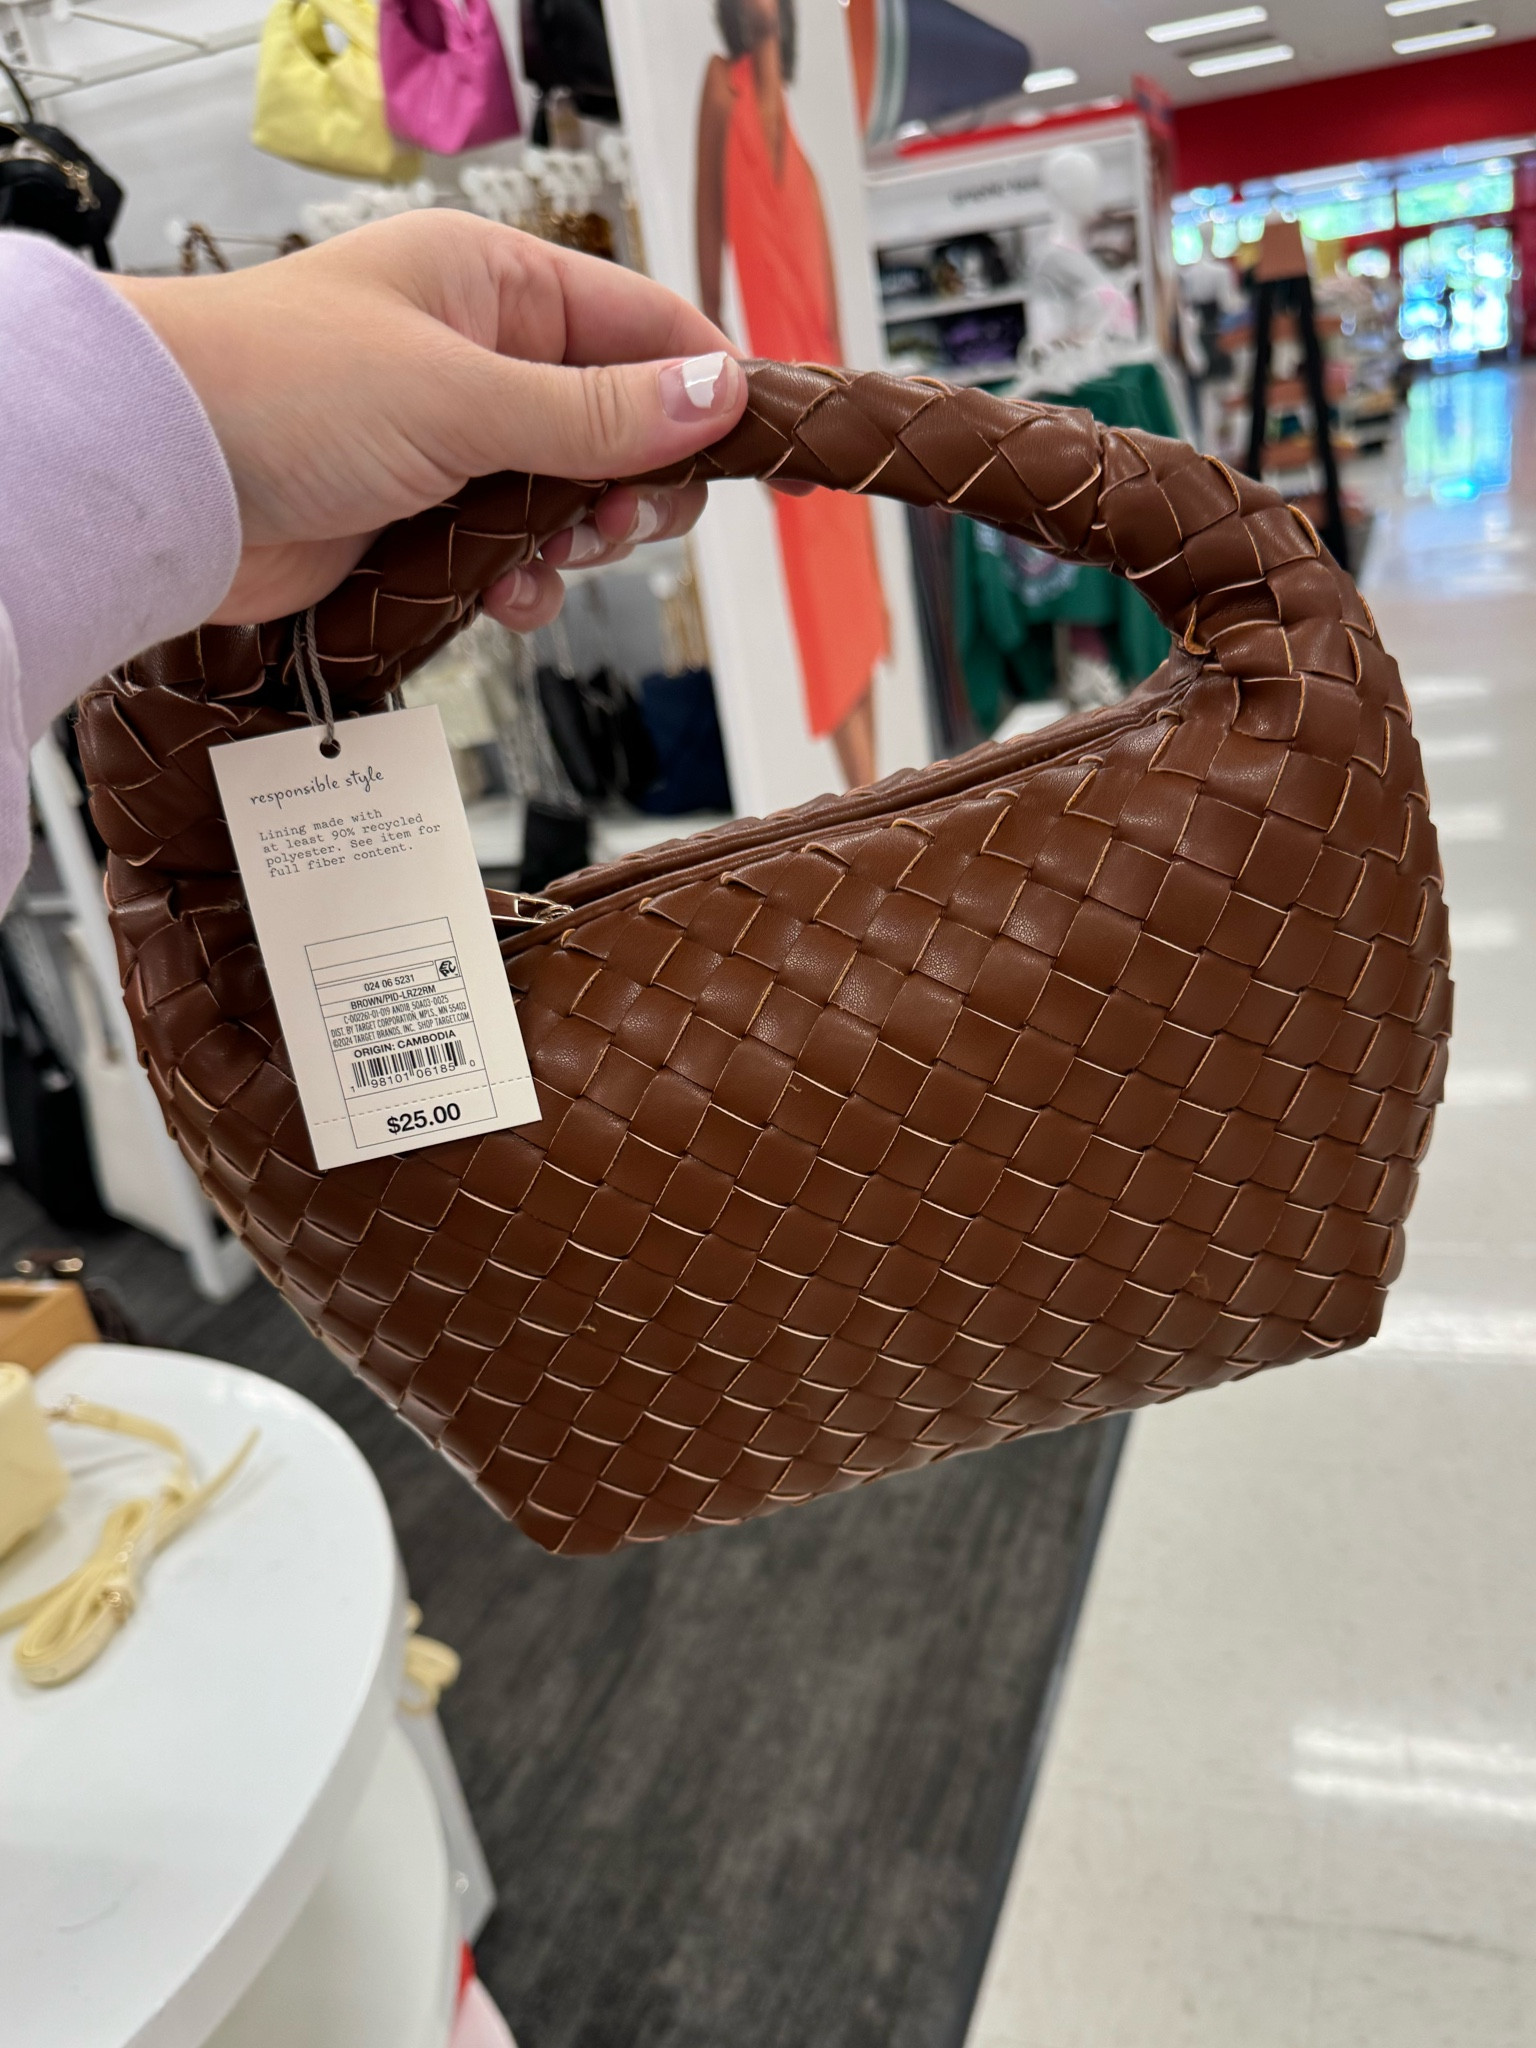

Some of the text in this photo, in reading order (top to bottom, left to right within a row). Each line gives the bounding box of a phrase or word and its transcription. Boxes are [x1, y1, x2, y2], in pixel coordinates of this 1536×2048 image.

[250, 766, 384, 809] responsible style
[259, 809, 383, 842] Lining made with
[263, 813, 423, 854] at least 90% recycled
[266, 823, 441, 868] polyester. See item for
[270, 843, 414, 878] full fiber content.
[351, 985, 436, 1010] BROWN/PID-LRZ2RM
[364, 974, 415, 992] 024 06 5231
[346, 1025, 354, 1035] BY
[355, 1021, 376, 1033] TARGET
[438, 1005, 448, 1015] MN
[449, 1001, 467, 1013] 55403
[354, 1032, 376, 1043] TARGET
[417, 1019, 433, 1030] SHOP
[434, 1011, 470, 1026] TARGET.COM
[354, 1030, 456, 1058] ORIGIN: CAMBODIA
[371, 1072, 410, 1088] 98101
[416, 1063, 456, 1079] 06185
[387, 1102, 461, 1135] $25.00
